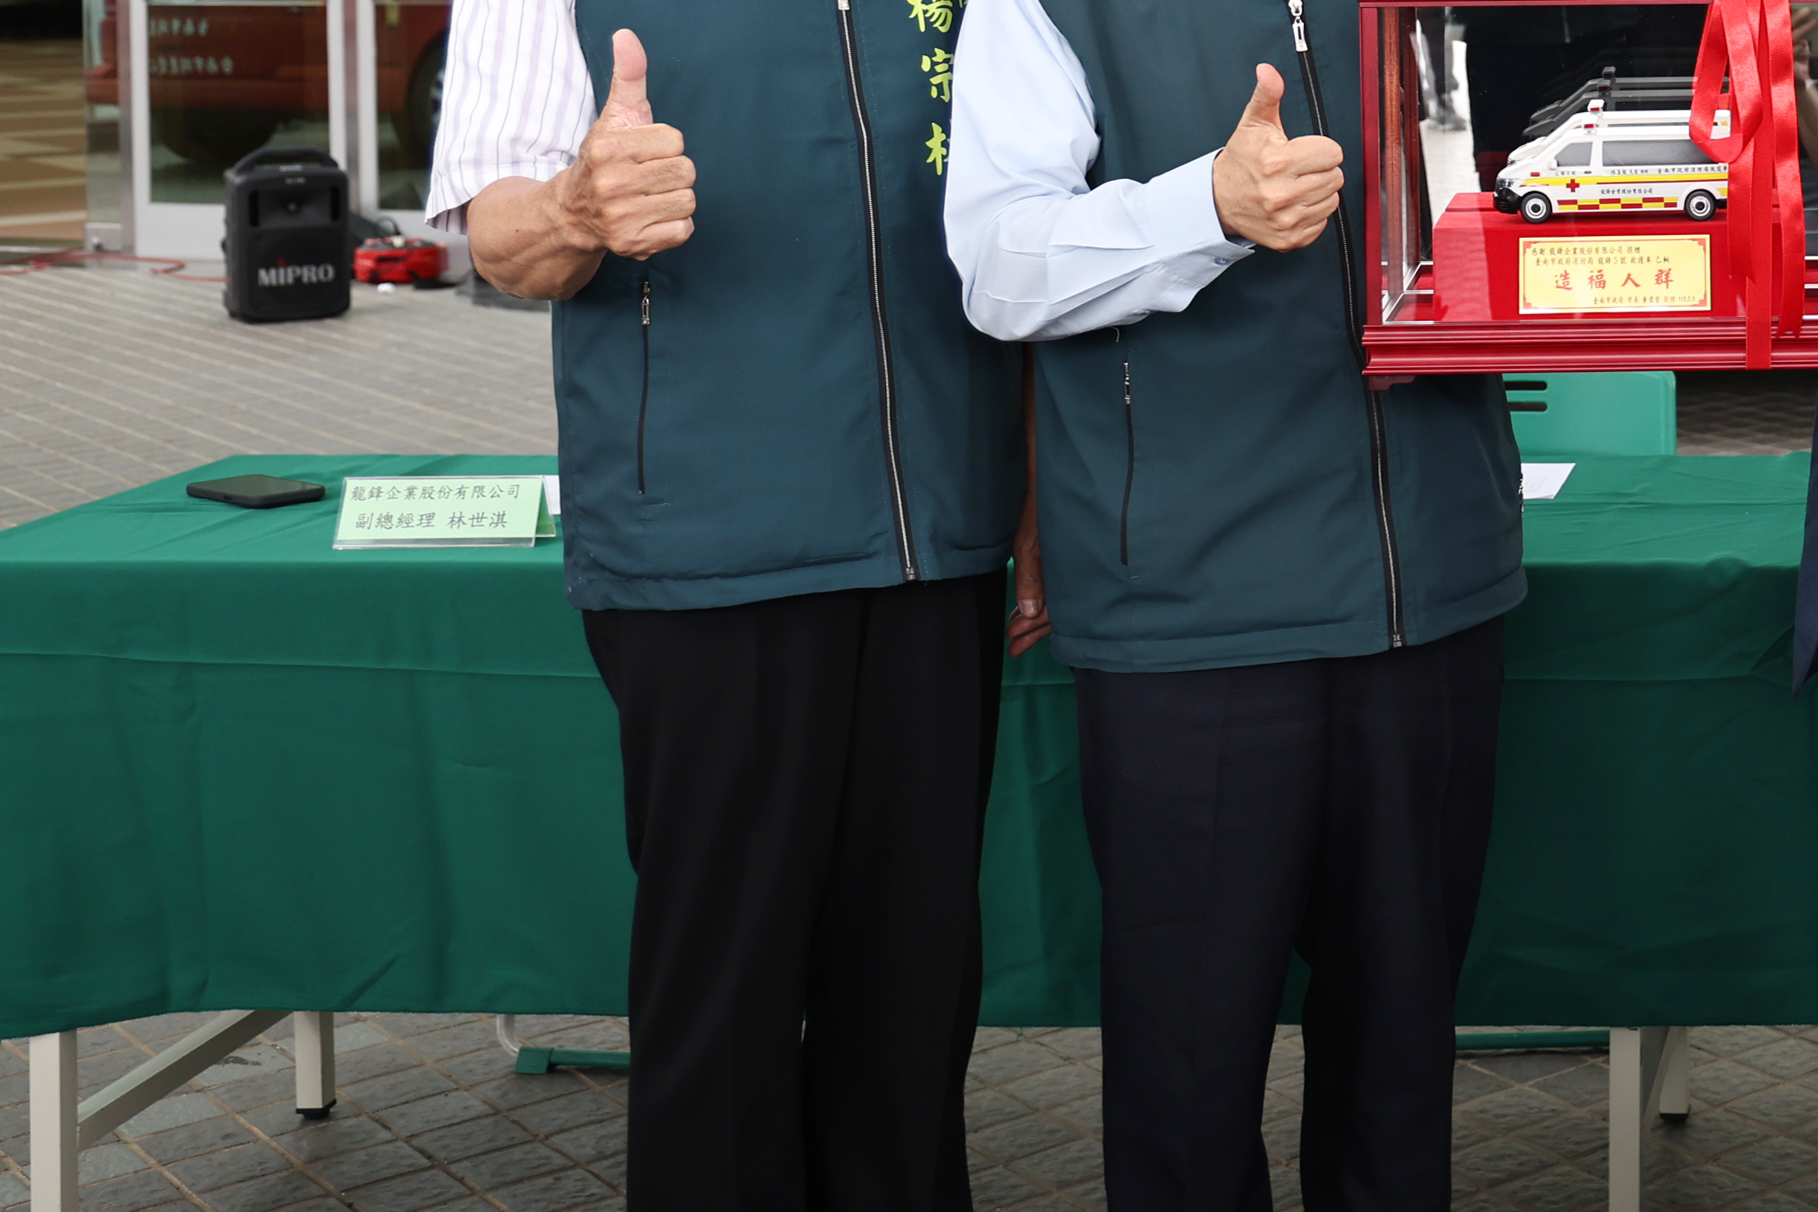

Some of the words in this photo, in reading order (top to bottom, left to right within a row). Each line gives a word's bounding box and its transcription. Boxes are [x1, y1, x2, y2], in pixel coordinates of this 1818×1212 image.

[1554, 268, 1673, 291] 造福人群
[350, 484, 520, 501] 龍鋒企業股份有限公司
[355, 512, 436, 530] 副總經理
